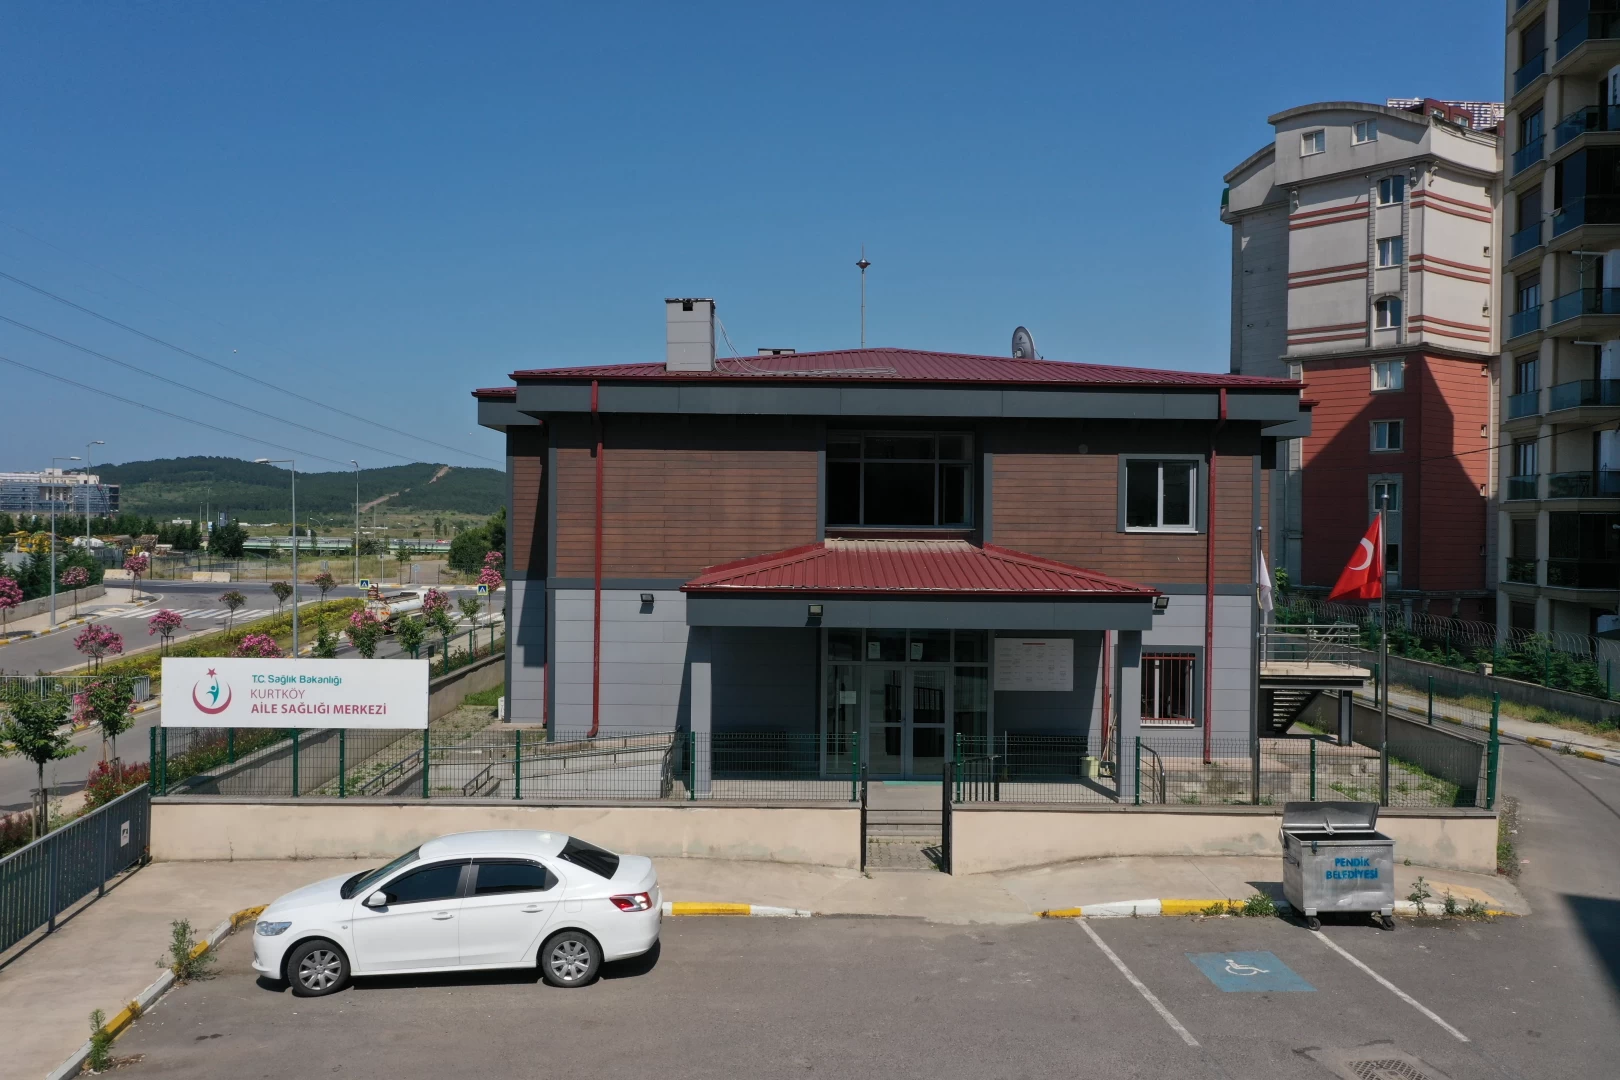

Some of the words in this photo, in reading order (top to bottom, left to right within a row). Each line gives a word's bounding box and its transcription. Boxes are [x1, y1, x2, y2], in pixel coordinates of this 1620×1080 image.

[268, 674, 297, 685] Sağlık
[300, 675, 342, 686] Bakanlığı
[250, 688, 305, 699] KURTKÖY
[251, 702, 278, 714] AİLE
[281, 702, 330, 714] SAĞLIĞI
[333, 703, 387, 715] MERKEZİ
[1335, 856, 1370, 867] PENDİK
[1326, 868, 1378, 879] BELEDİYESİ
